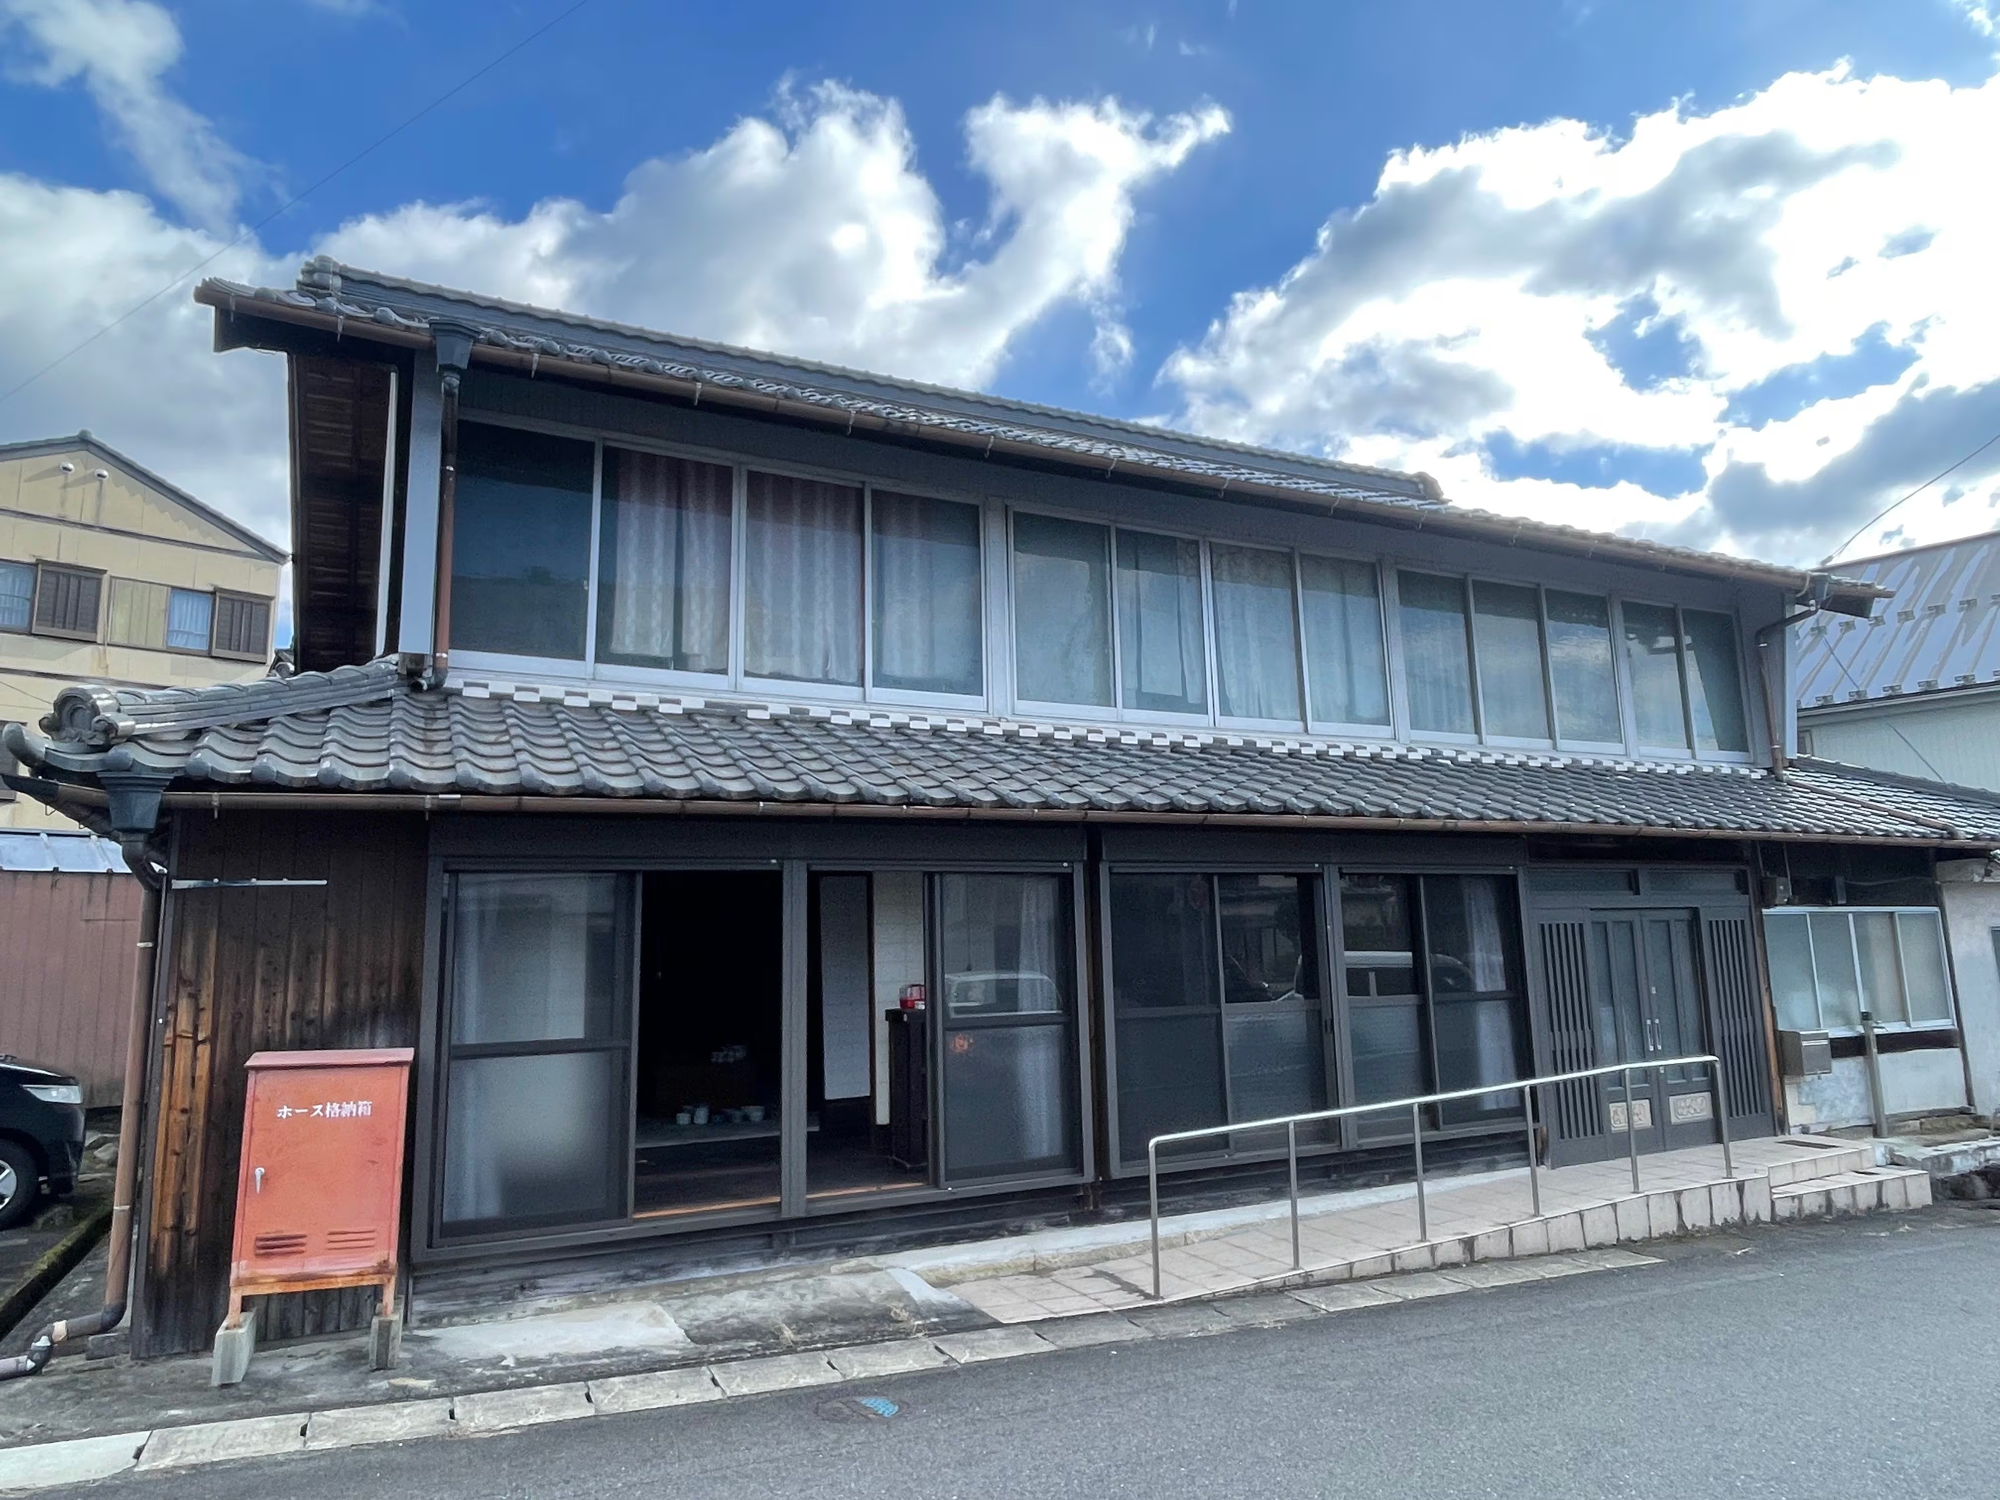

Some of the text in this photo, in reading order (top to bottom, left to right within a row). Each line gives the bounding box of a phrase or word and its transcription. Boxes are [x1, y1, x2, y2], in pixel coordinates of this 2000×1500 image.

[276, 1100, 373, 1119] ホース格納箱
